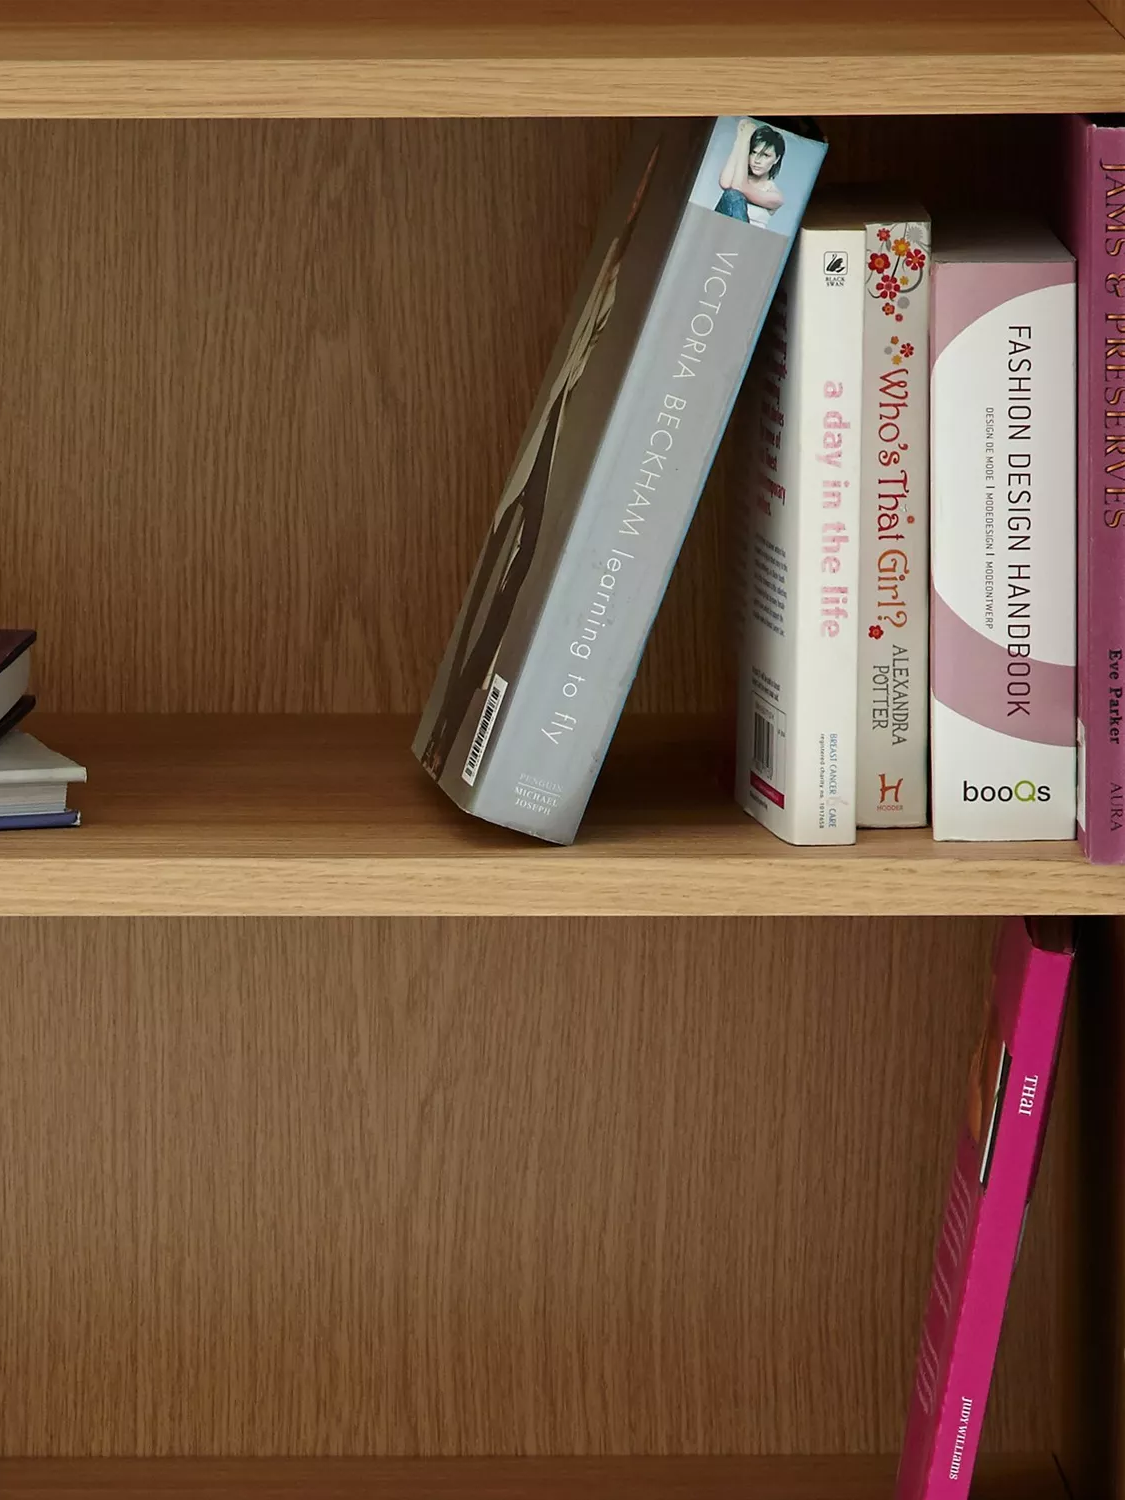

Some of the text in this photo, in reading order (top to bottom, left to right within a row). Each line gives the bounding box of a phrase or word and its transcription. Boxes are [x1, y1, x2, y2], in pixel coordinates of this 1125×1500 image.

[1100, 158, 1125, 256] JAMS
[985, 407, 995, 481] DESIGN DE MODE
[1104, 313, 1125, 529] PRESERVES
[541, 250, 739, 746] VICTORIA BECKHAM learning to fly
[816, 379, 851, 638] a day in the life
[876, 367, 911, 629] Who's That Girl?
[985, 492, 995, 550] MODEDESIGN
[1006, 325, 1032, 718] FASHION DESIGN HANDBOOK
[985, 561, 995, 630] MODEONTWERP
[872, 664, 890, 730] POTTER
[891, 643, 910, 746] ALEXANDRA
[1108, 648, 1123, 745] Eve Parker
[515, 786, 559, 808] MICHAEL
[515, 798, 551, 815] JOSEPH
[828, 733, 838, 828] BREAST CANCER CARE
[876, 803, 904, 811] HODDER
[963, 780, 1051, 802] booQs
[1109, 781, 1123, 832] AURA
[960, 1396, 972, 1425] JUDY
